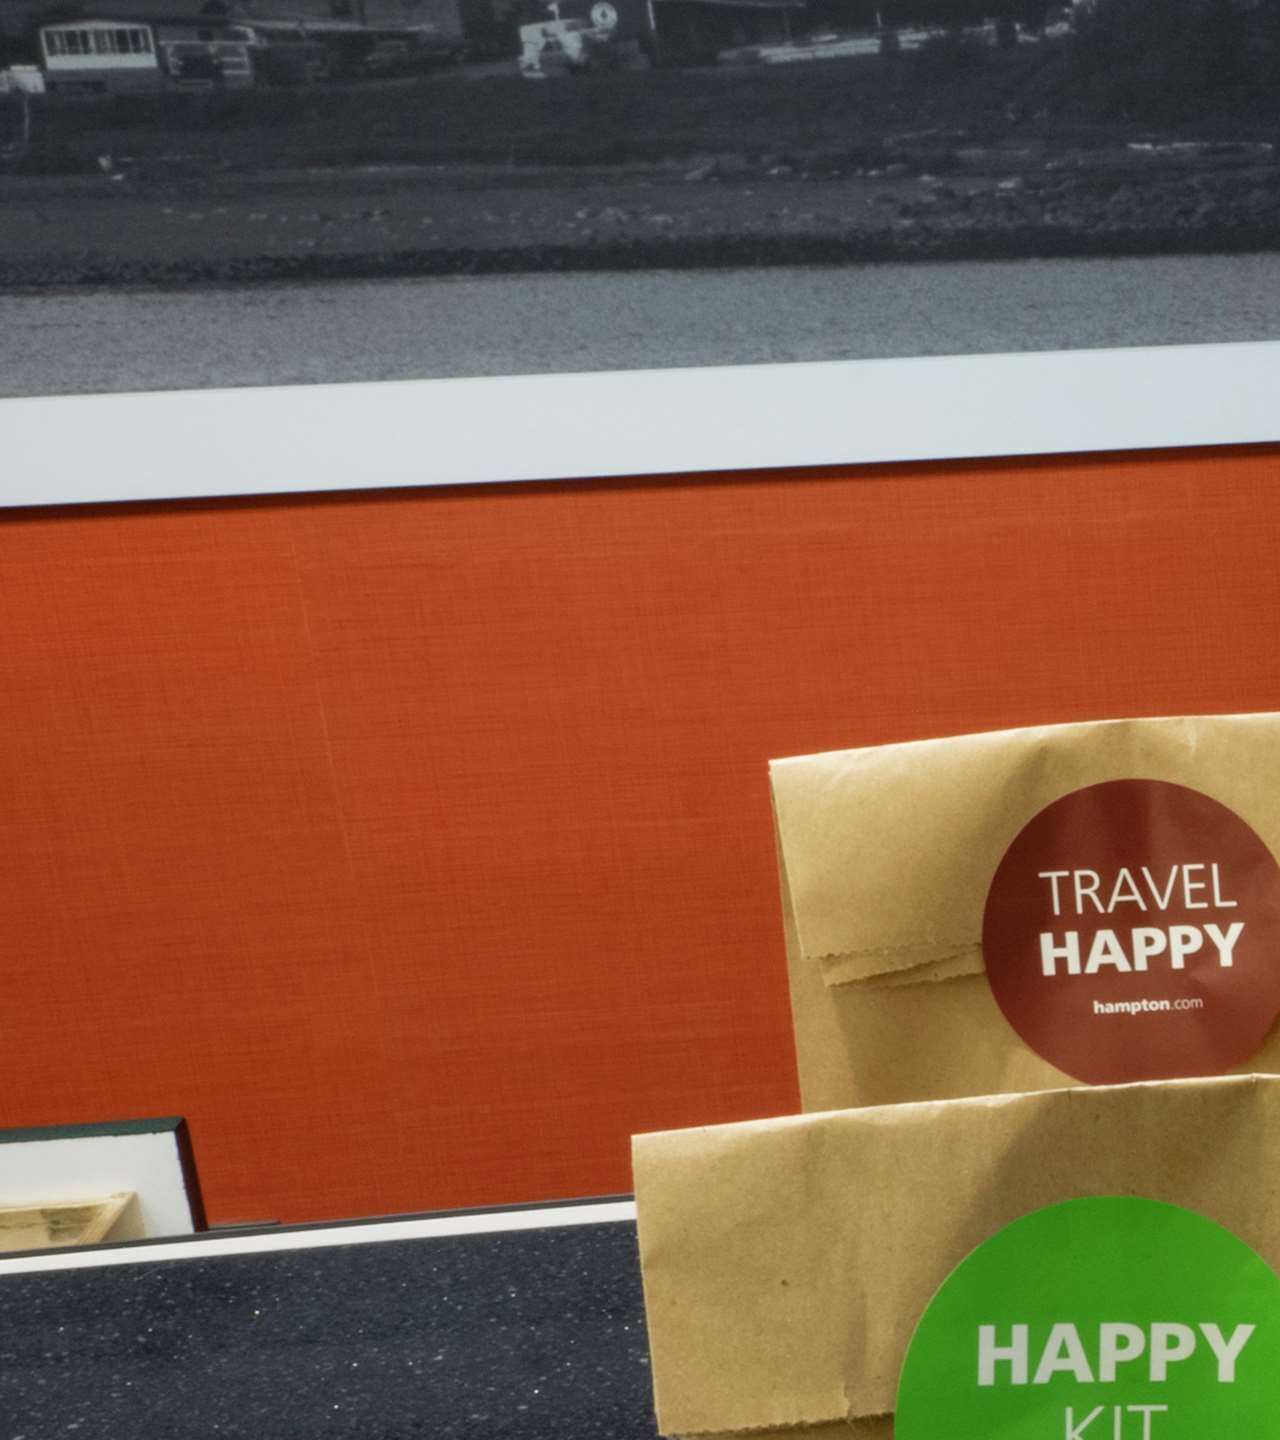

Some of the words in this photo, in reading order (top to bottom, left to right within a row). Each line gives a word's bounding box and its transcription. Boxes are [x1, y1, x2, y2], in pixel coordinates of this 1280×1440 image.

[1038, 863, 1238, 916] TRAVEL
[1040, 922, 1246, 977] HAPPY
[1093, 997, 1204, 1015] hampton.com
[977, 1322, 1257, 1387] HAPPY
